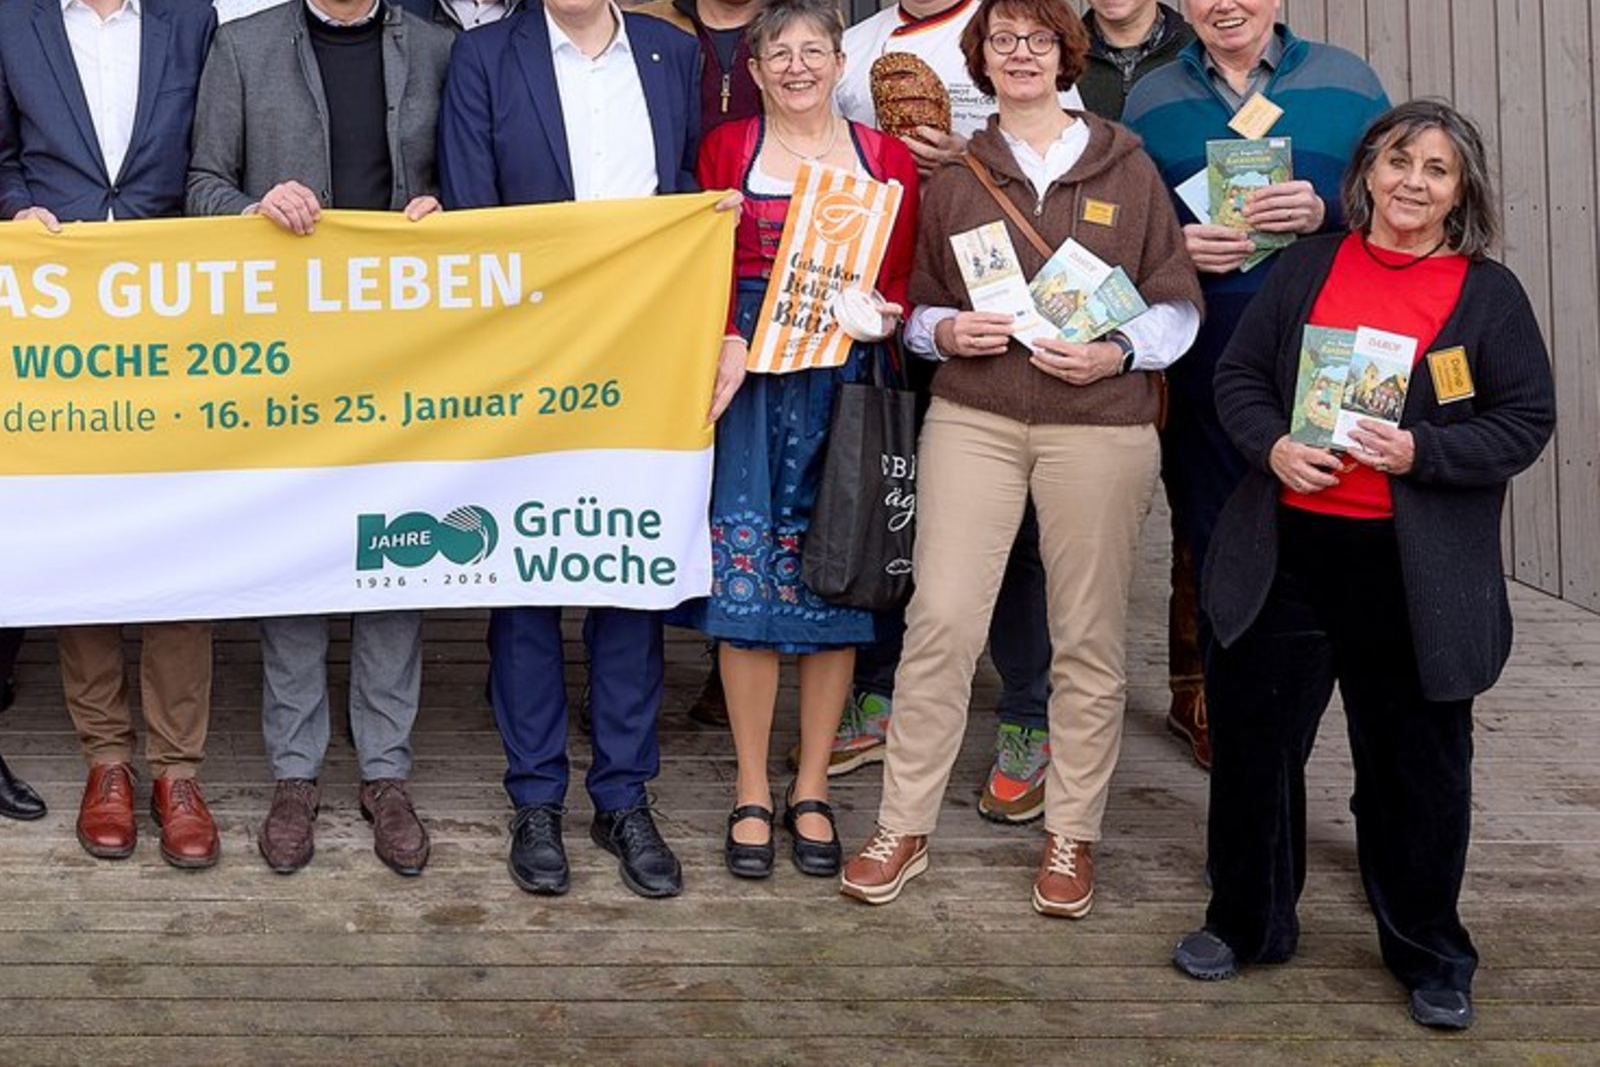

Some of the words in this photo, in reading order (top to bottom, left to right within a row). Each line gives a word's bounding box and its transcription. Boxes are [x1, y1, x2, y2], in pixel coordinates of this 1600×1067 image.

[98, 259, 277, 318] GUTE
[307, 253, 543, 313] LEBEN.
[13, 343, 169, 379] WOCHE
[187, 341, 290, 376] 2026
[199, 401, 250, 430] 16.
[266, 394, 320, 427] bis
[334, 394, 387, 424] 25.
[401, 390, 523, 428] Januar
[538, 380, 621, 415] 2026
[513, 497, 661, 539] Grüne
[369, 530, 432, 550] JAHRE
[356, 576, 406, 589] 1926
[443, 572, 498, 586] 2026
[513, 545, 677, 586] Woche
